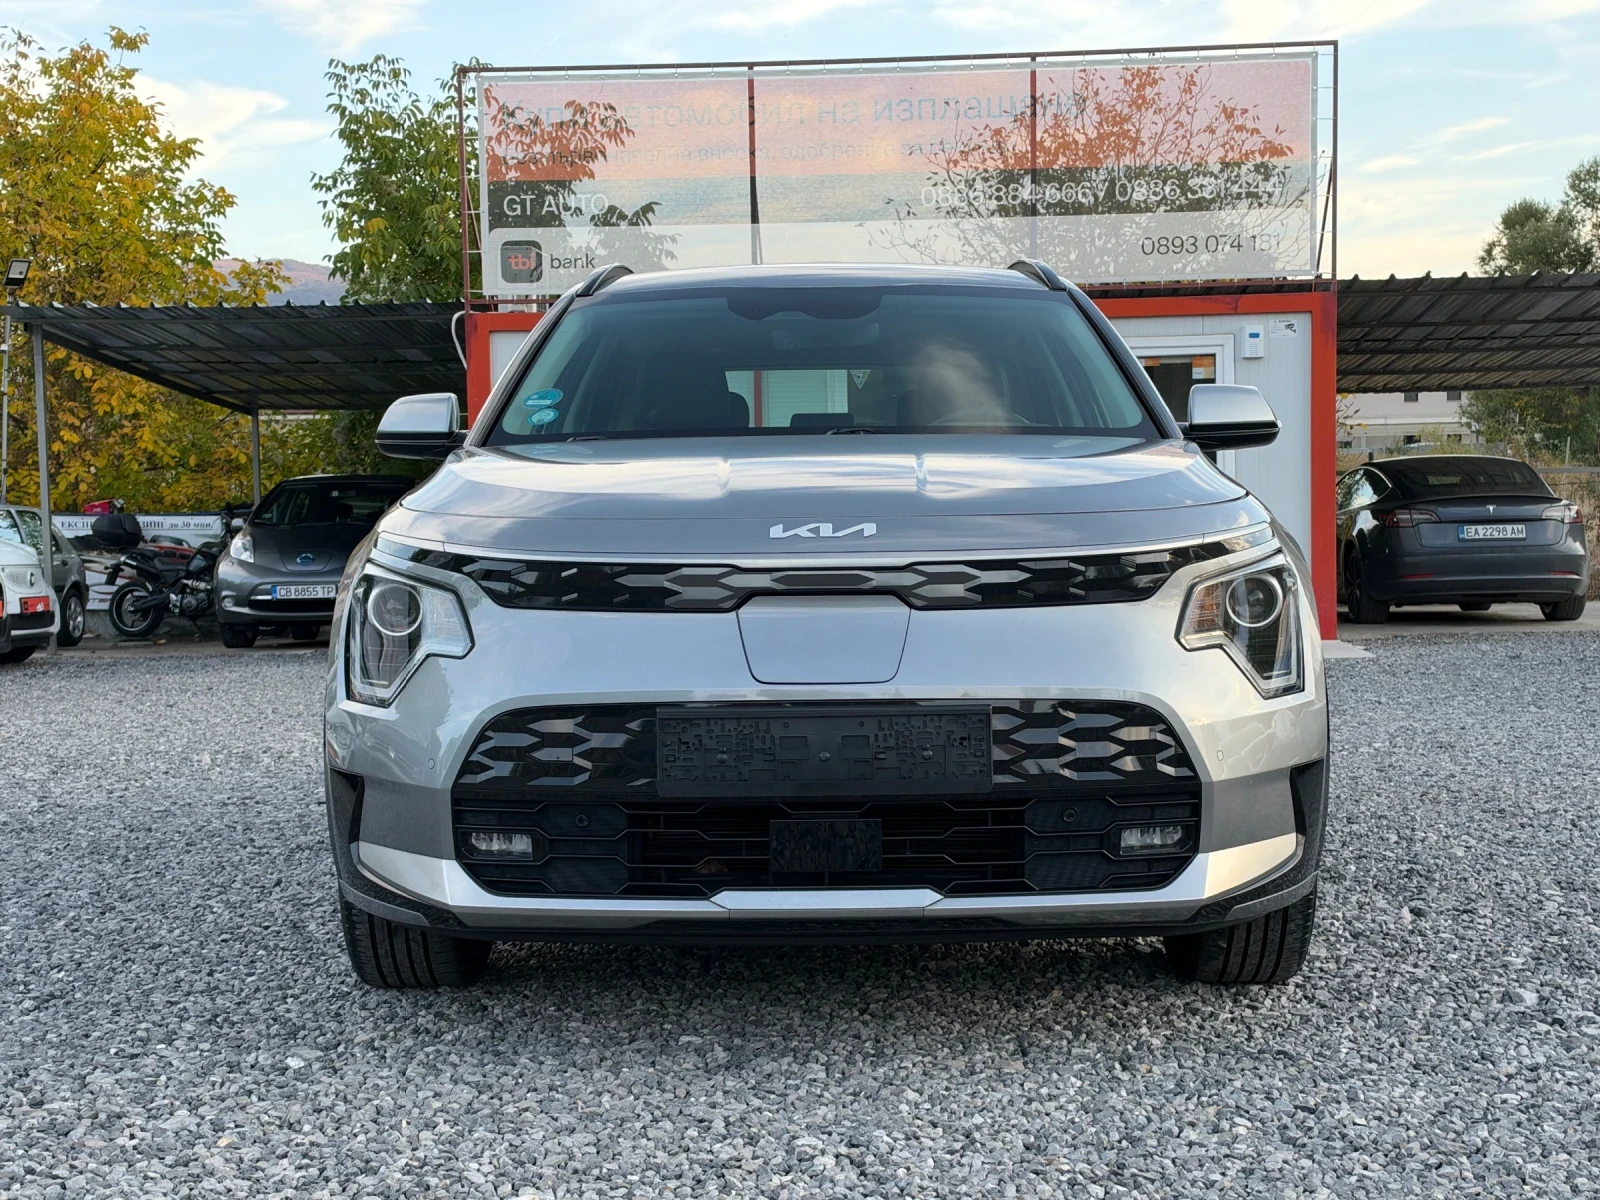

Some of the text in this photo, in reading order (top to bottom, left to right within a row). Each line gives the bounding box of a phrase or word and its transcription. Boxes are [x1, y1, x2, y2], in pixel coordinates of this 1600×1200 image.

[817, 99, 860, 124] на
[920, 186, 985, 207] 0886
[992, 184, 1038, 205] 884
[1044, 181, 1092, 204] 666
[1114, 178, 1181, 202] 0886
[502, 192, 610, 217] GT AUTO
[1140, 234, 1200, 256] 0893
[1204, 233, 1244, 254] 074
[507, 249, 597, 271] tbi bank
[180, 520, 191, 529] 30
[1465, 526, 1524, 537] EA 2298 AM
[278, 586, 334, 597] CB 8855 TP
